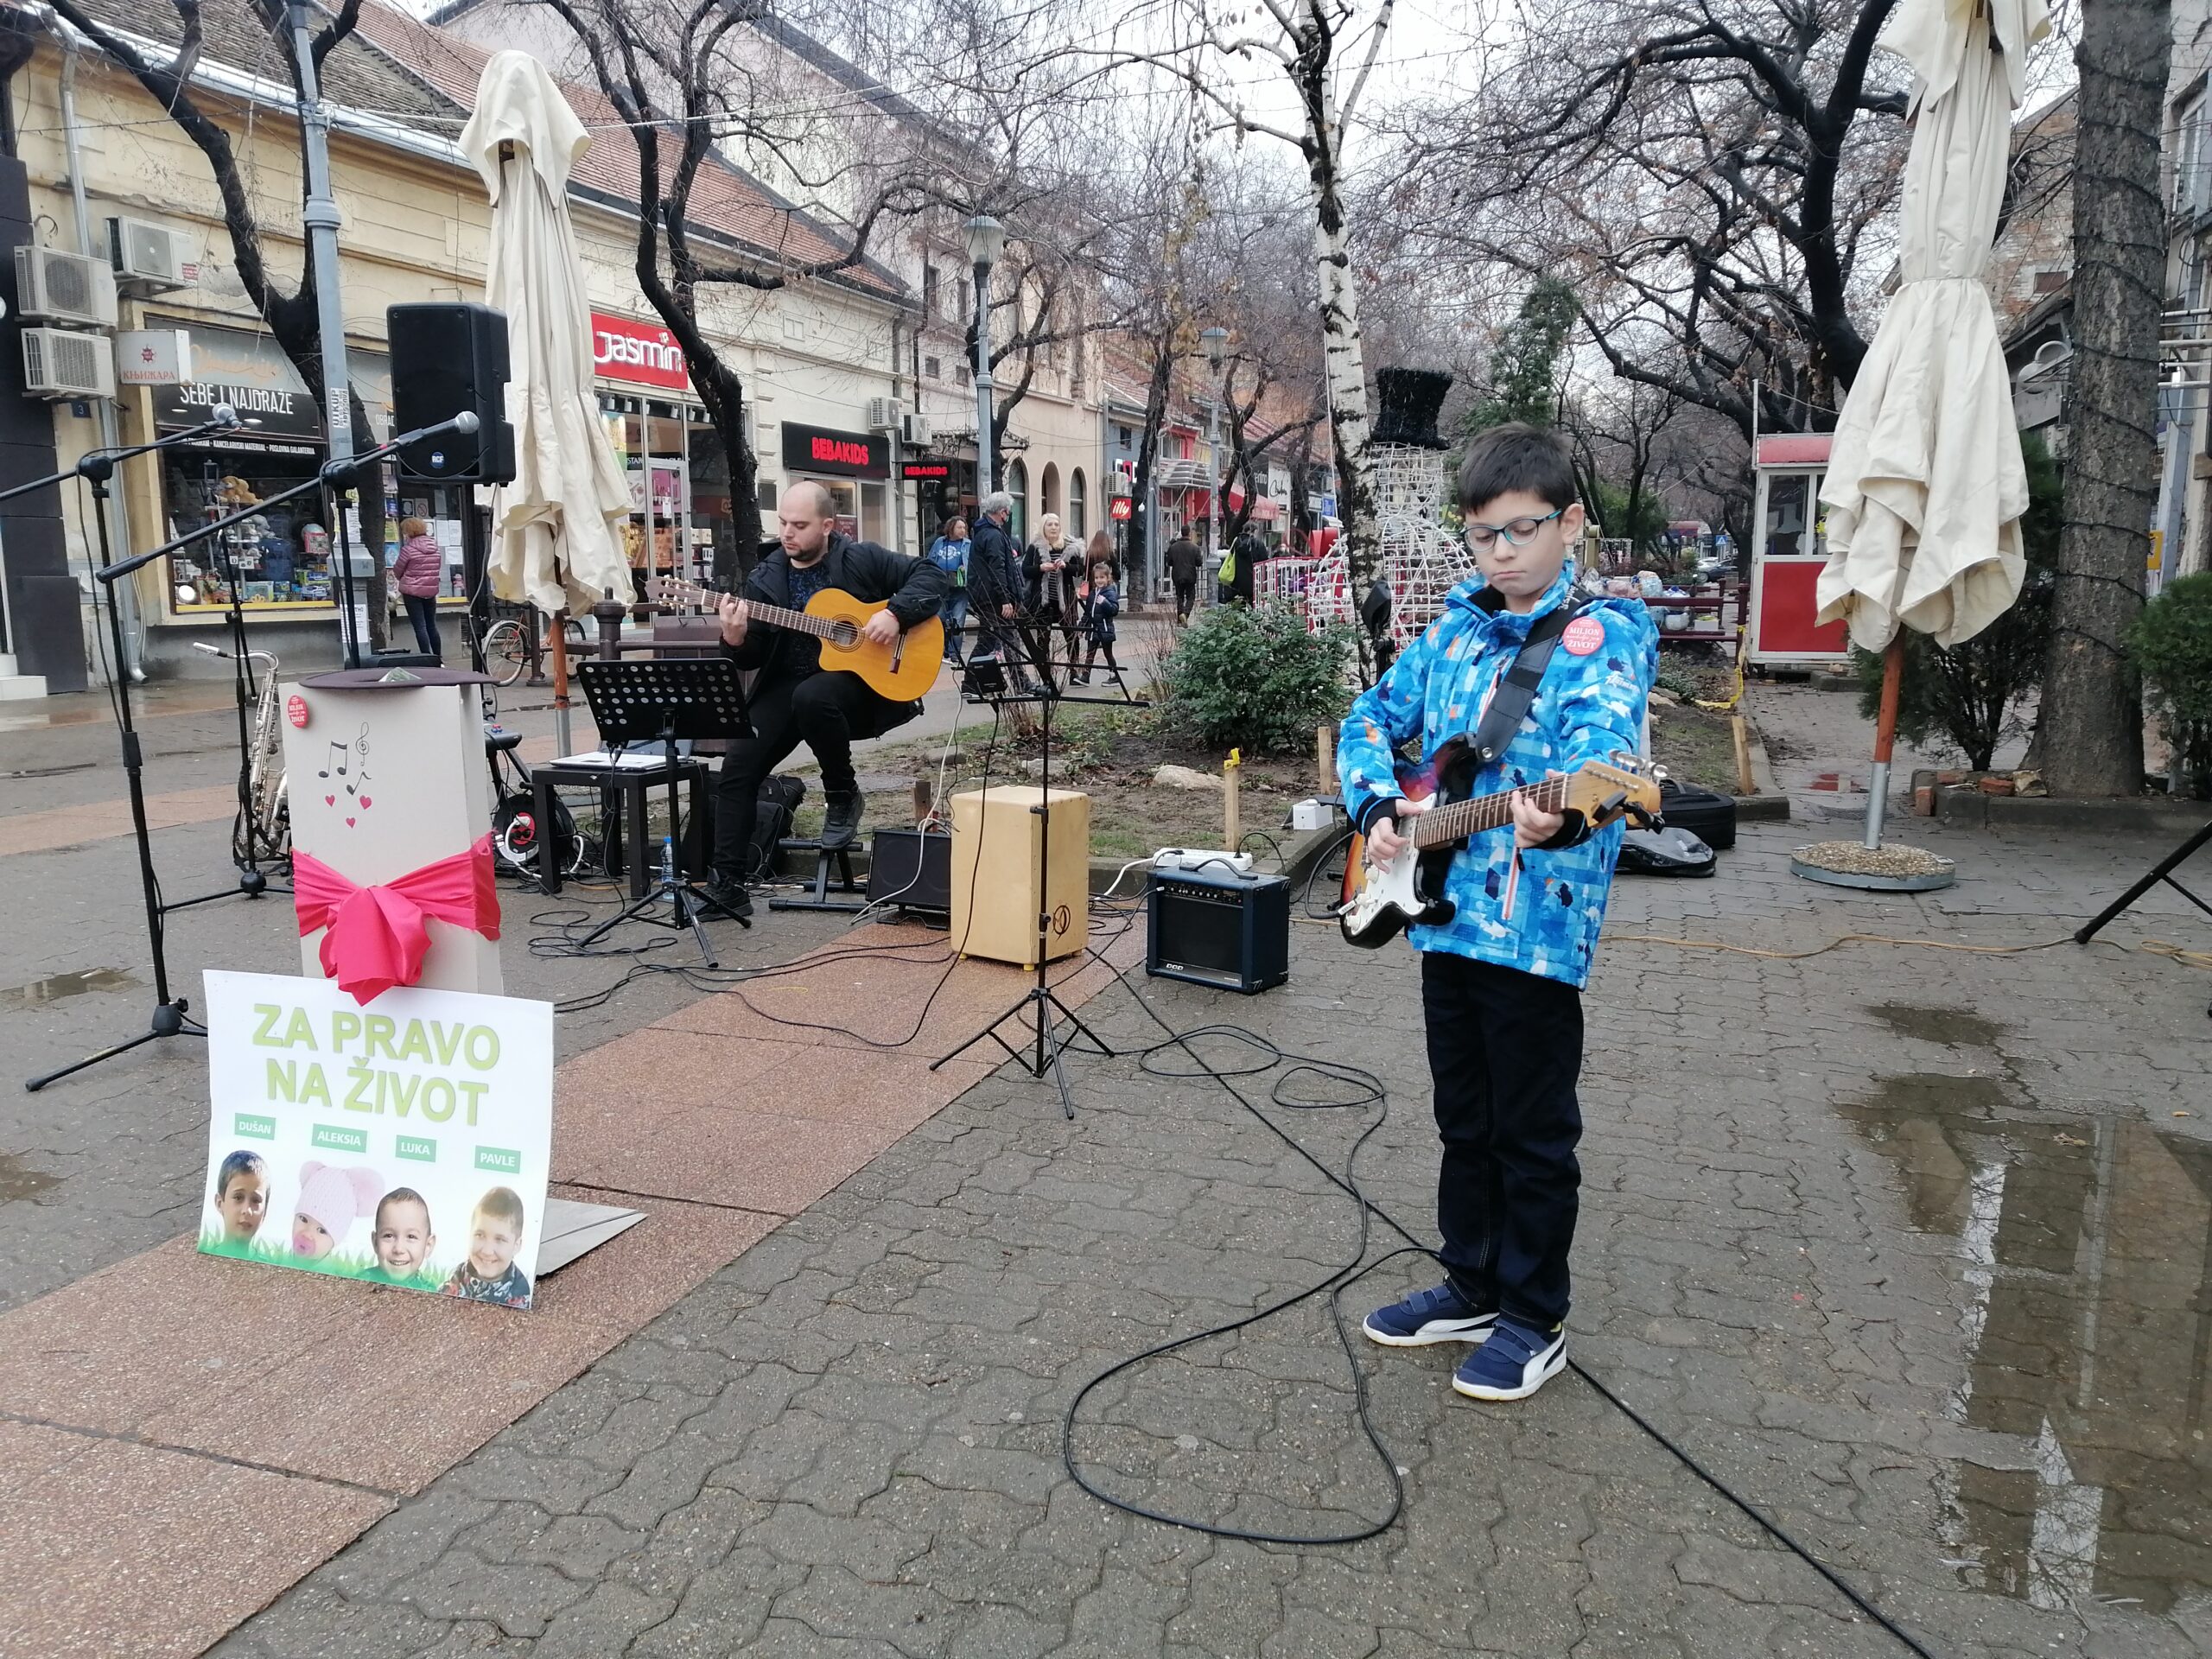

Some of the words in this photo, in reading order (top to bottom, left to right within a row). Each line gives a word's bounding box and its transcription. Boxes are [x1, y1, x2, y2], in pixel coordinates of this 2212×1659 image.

[594, 330, 683, 372] Jasmin
[124, 371, 175, 380] КЊИЖАРА
[180, 383, 215, 406] SEBE
[228, 387, 294, 415] NAJDRAŽE
[811, 436, 869, 466] BEBAKIDS
[905, 466, 948, 476] BEBAKIDS
[1112, 500, 1130, 518] illy
[1569, 626, 1600, 636] MILION
[252, 1003, 319, 1051] ZA
[332, 1010, 500, 1071] PRAVO
[266, 1058, 333, 1108] NA
[343, 1056, 489, 1127] ŽIVOT
[238, 1121, 271, 1135] DUŠAN
[317, 1130, 361, 1147] ALEKSIA
[401, 1141, 430, 1155] LUKA
[480, 1152, 516, 1167] PAVLE
